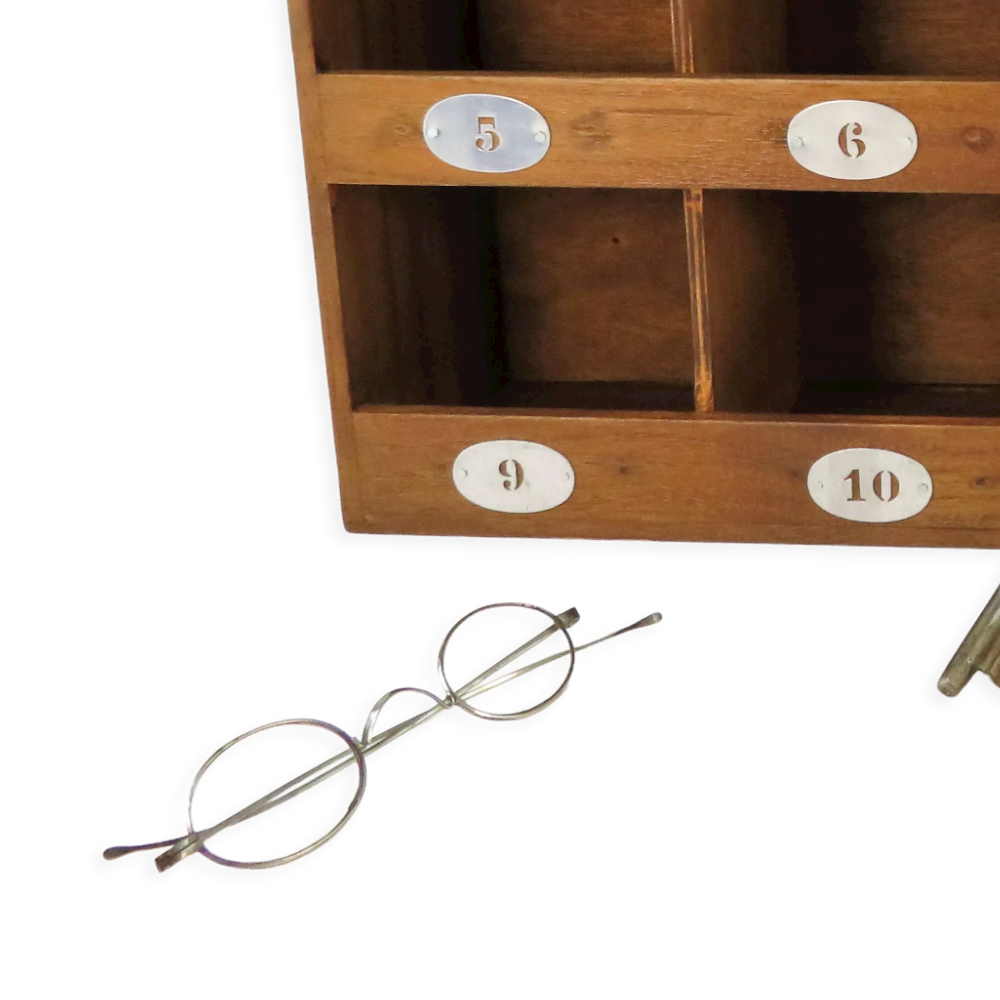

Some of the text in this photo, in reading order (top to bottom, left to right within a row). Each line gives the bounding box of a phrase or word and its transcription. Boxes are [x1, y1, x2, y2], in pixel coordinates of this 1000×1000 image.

[475, 117, 501, 152] 5
[838, 122, 867, 159] 6
[498, 459, 524, 492] 9
[844, 469, 900, 503] 10
